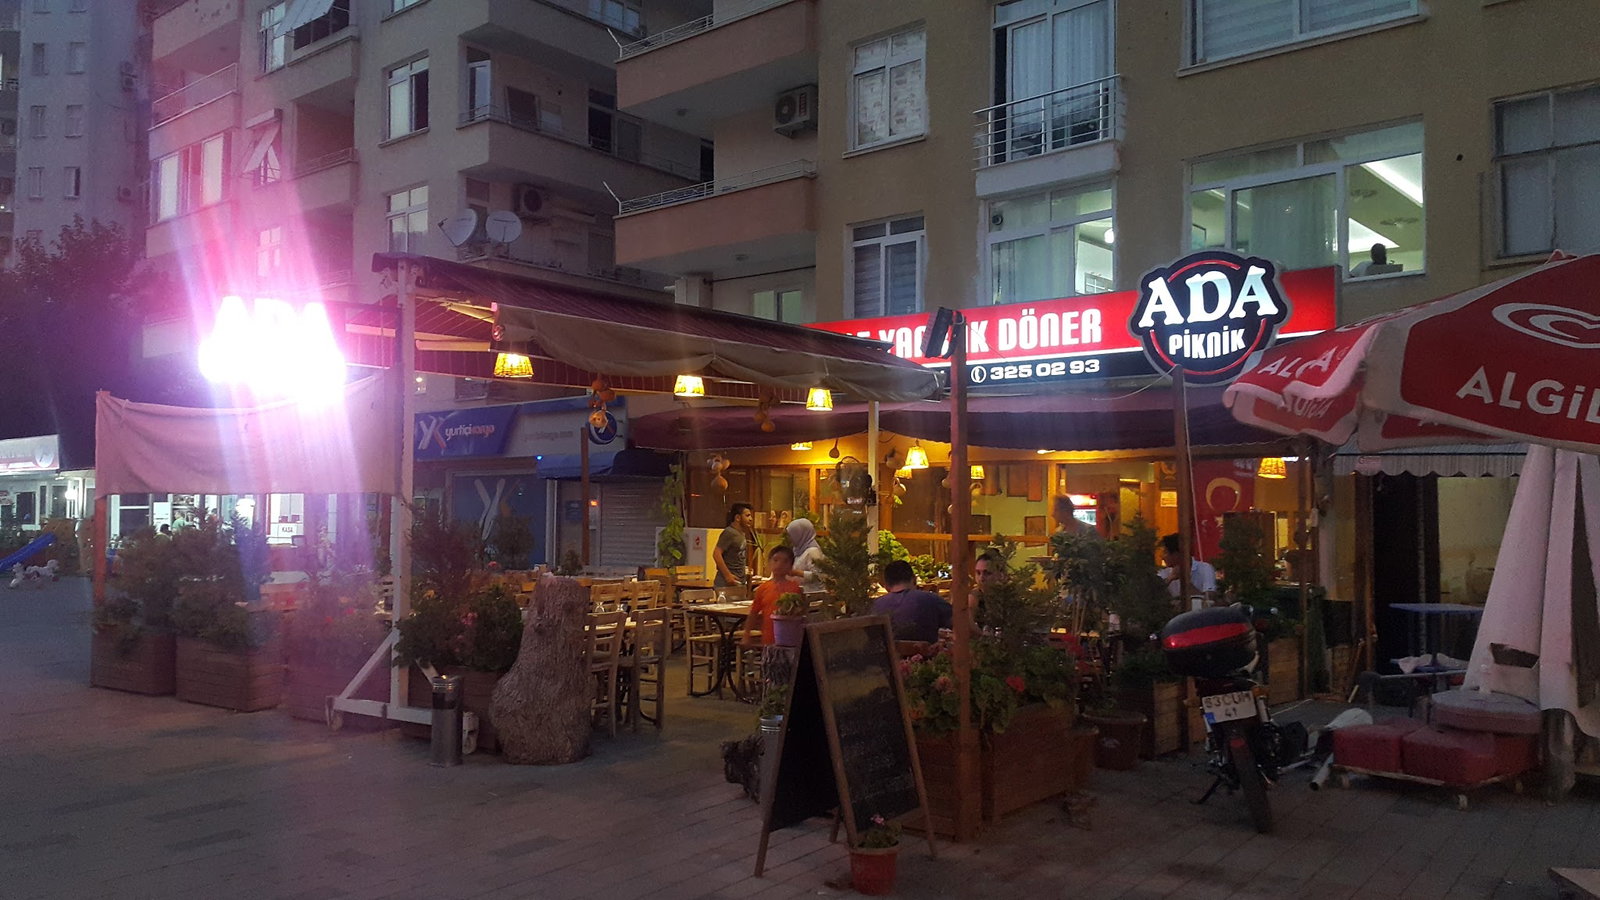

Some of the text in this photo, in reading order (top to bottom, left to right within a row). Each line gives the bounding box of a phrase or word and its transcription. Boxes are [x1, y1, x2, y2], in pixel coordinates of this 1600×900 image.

[1138, 265, 1279, 328] ADA
[998, 308, 1103, 352] DÖNER
[990, 359, 1100, 380] 325 02 93
